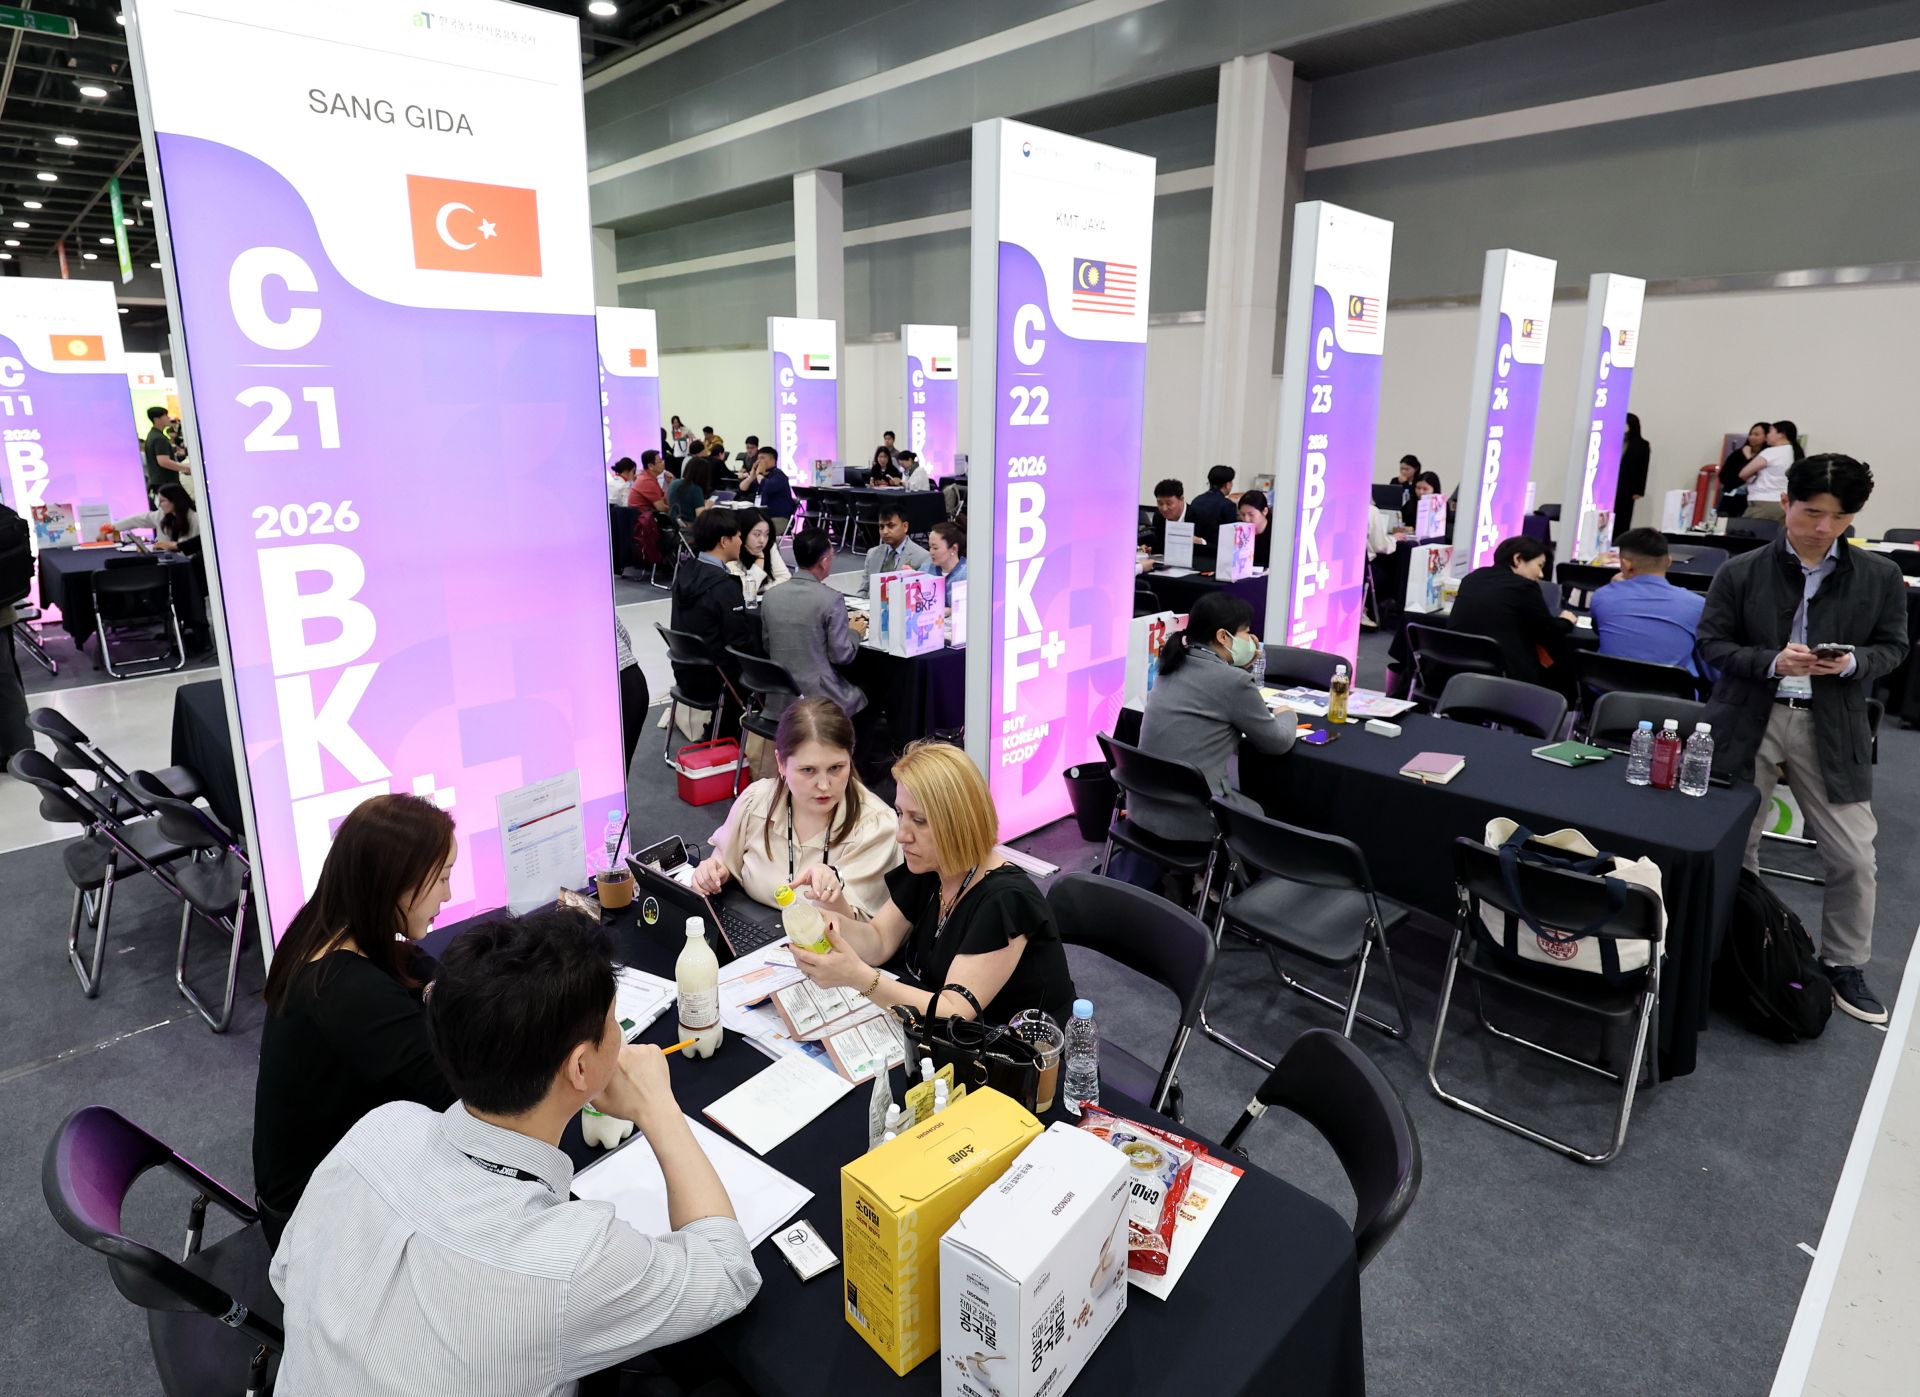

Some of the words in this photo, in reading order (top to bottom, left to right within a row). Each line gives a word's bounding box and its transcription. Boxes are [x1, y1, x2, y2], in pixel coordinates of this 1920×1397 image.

[308, 88, 395, 125] SANG
[404, 104, 474, 137] GIDA
[228, 246, 323, 351] C
[1013, 303, 1047, 367] C
[1315, 326, 1334, 371] C
[0, 356, 26, 388] C
[1498, 343, 1512, 378] C
[1600, 351, 1611, 381] C
[780, 367, 794, 388] C
[912, 369, 924, 388] C
[0, 395, 34, 416] 11
[780, 391, 798, 406] 14
[912, 391, 926, 404] 15
[1009, 385, 1050, 426] 22
[1310, 384, 1333, 413] 23
[234, 385, 341, 452] 21
[3, 429, 42, 441] 2026
[1007, 455, 1048, 479] 2026
[251, 499, 361, 540] 2026
[1002, 713, 1027, 735] BUY
[1002, 722, 1050, 751] KOREAN
[1051, 1191, 1076, 1217] ODONGRI
[1131, 1183, 1160, 1206] COLD
[898, 1208, 920, 1366] SOYMEAL
[960, 1297, 977, 1317] 진하고
[959, 1309, 997, 1351] 콩국물
[1031, 1310, 1065, 1373] 콩국물
